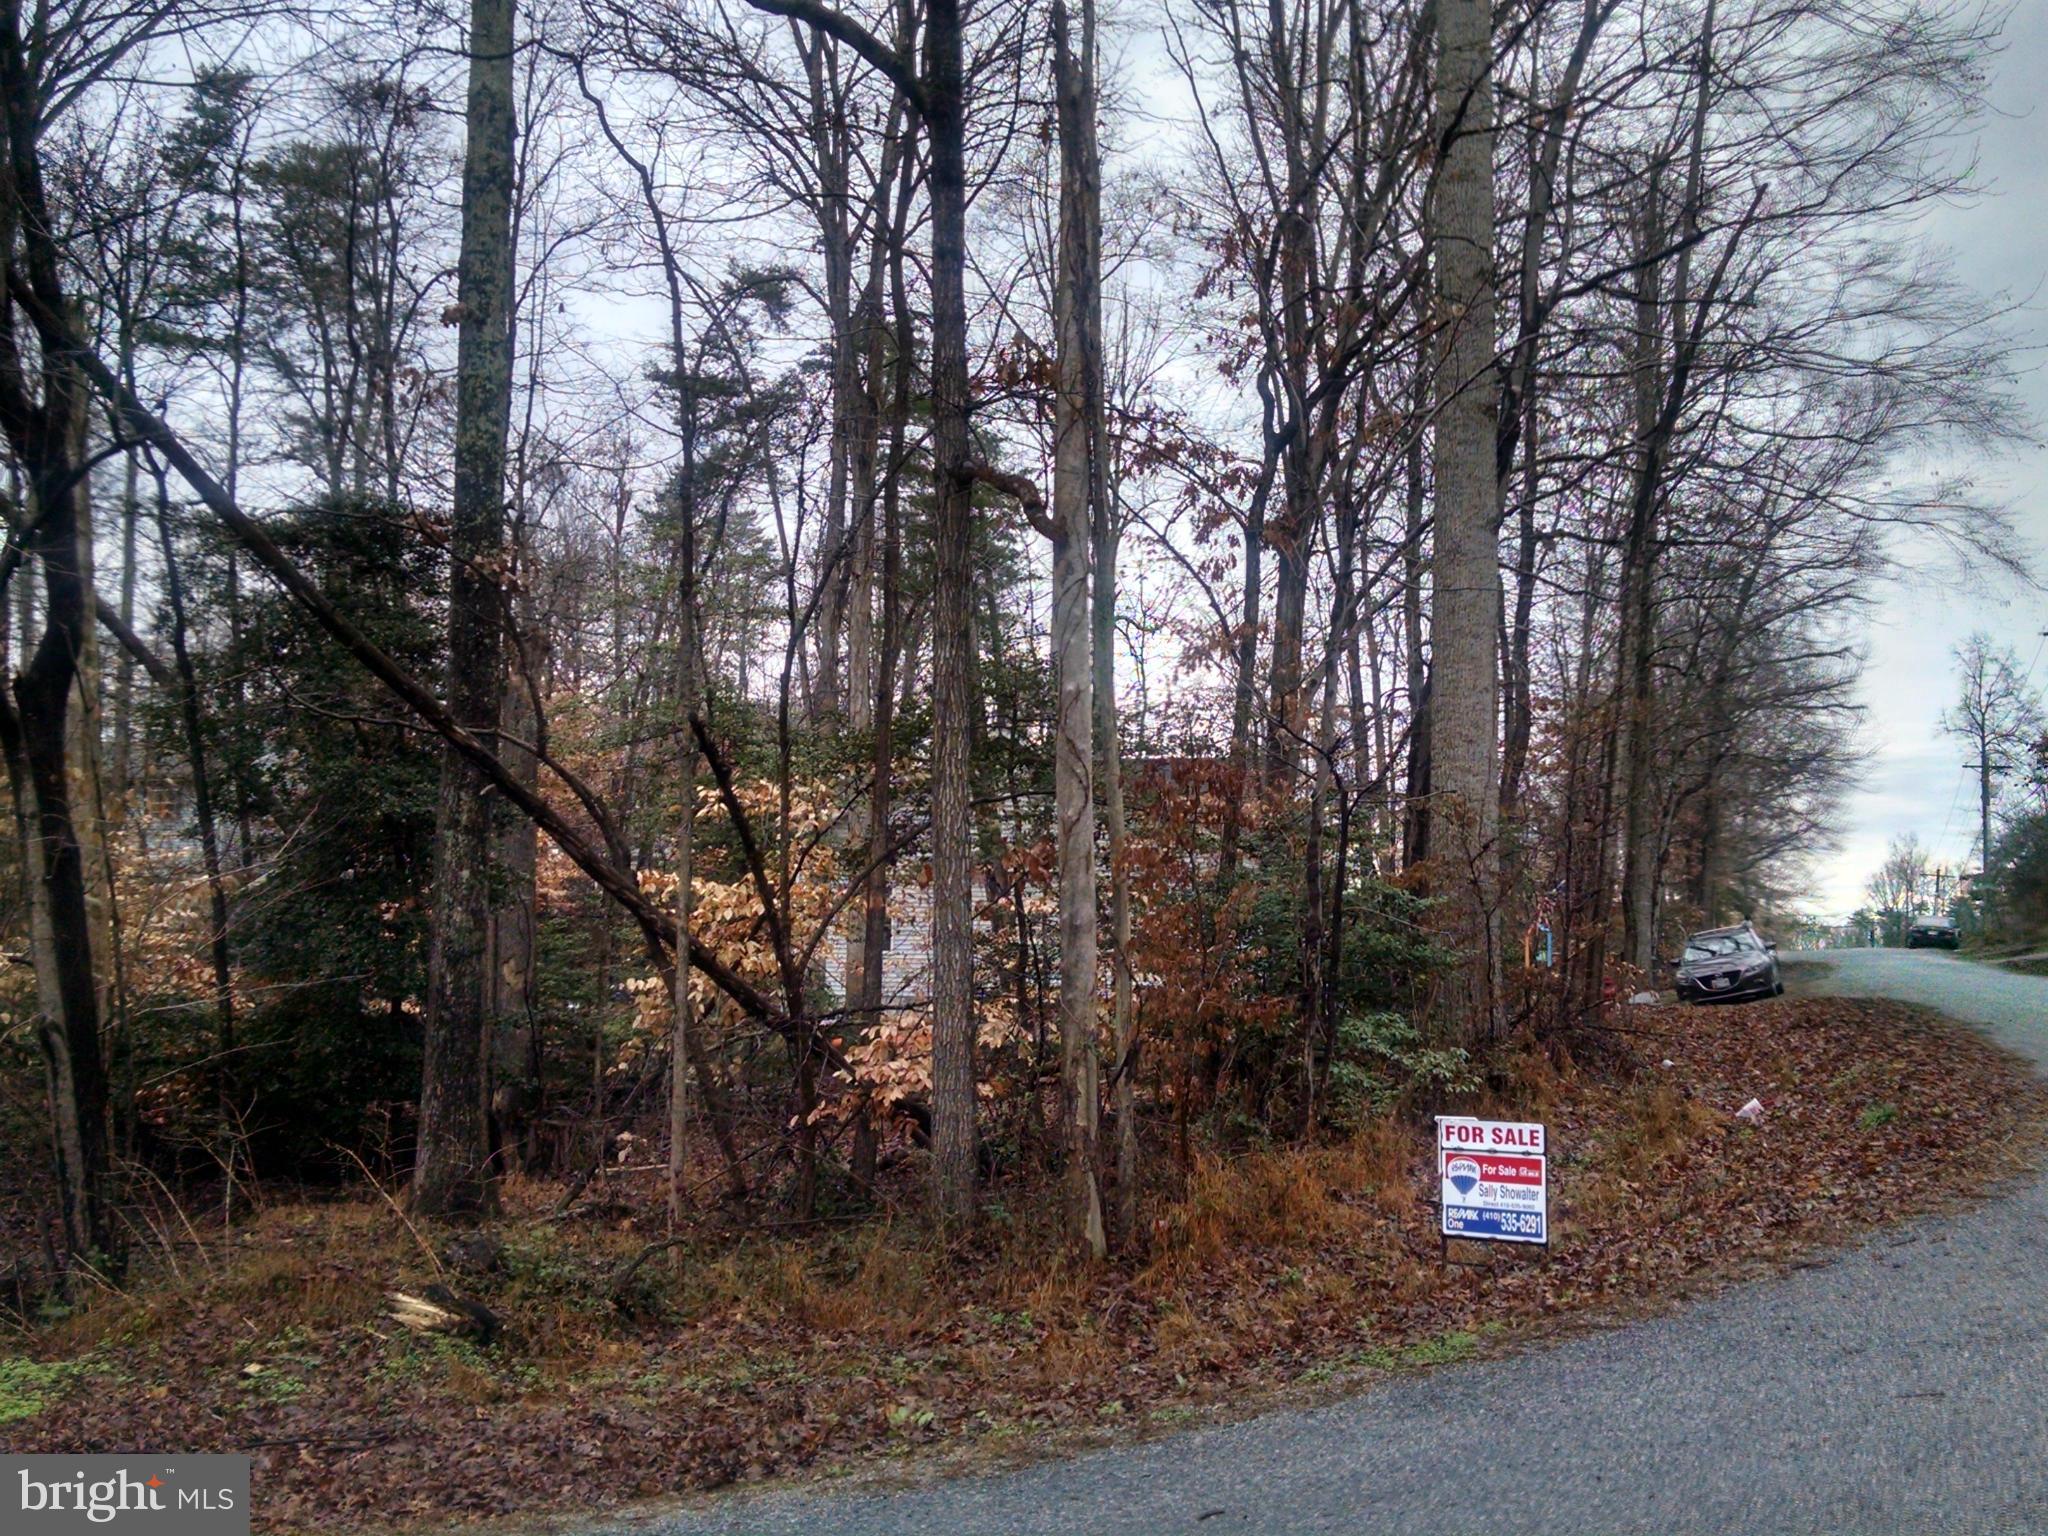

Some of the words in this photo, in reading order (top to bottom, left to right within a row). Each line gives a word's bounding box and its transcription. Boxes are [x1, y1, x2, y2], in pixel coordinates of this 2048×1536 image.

[1445, 1125, 1484, 1144] FOR
[1492, 1127, 1540, 1147] SALE
[1482, 1163, 1497, 1175] For
[1498, 1165, 1517, 1177] Sale
[1479, 1183, 1498, 1201] Sally
[1500, 1185, 1539, 1201] Showalter
[1447, 1219, 1464, 1230] One
[1448, 1207, 1480, 1221] RE/MAX
[1482, 1211, 1500, 1222] (410)
[1501, 1213, 1541, 1234] 535-6291
